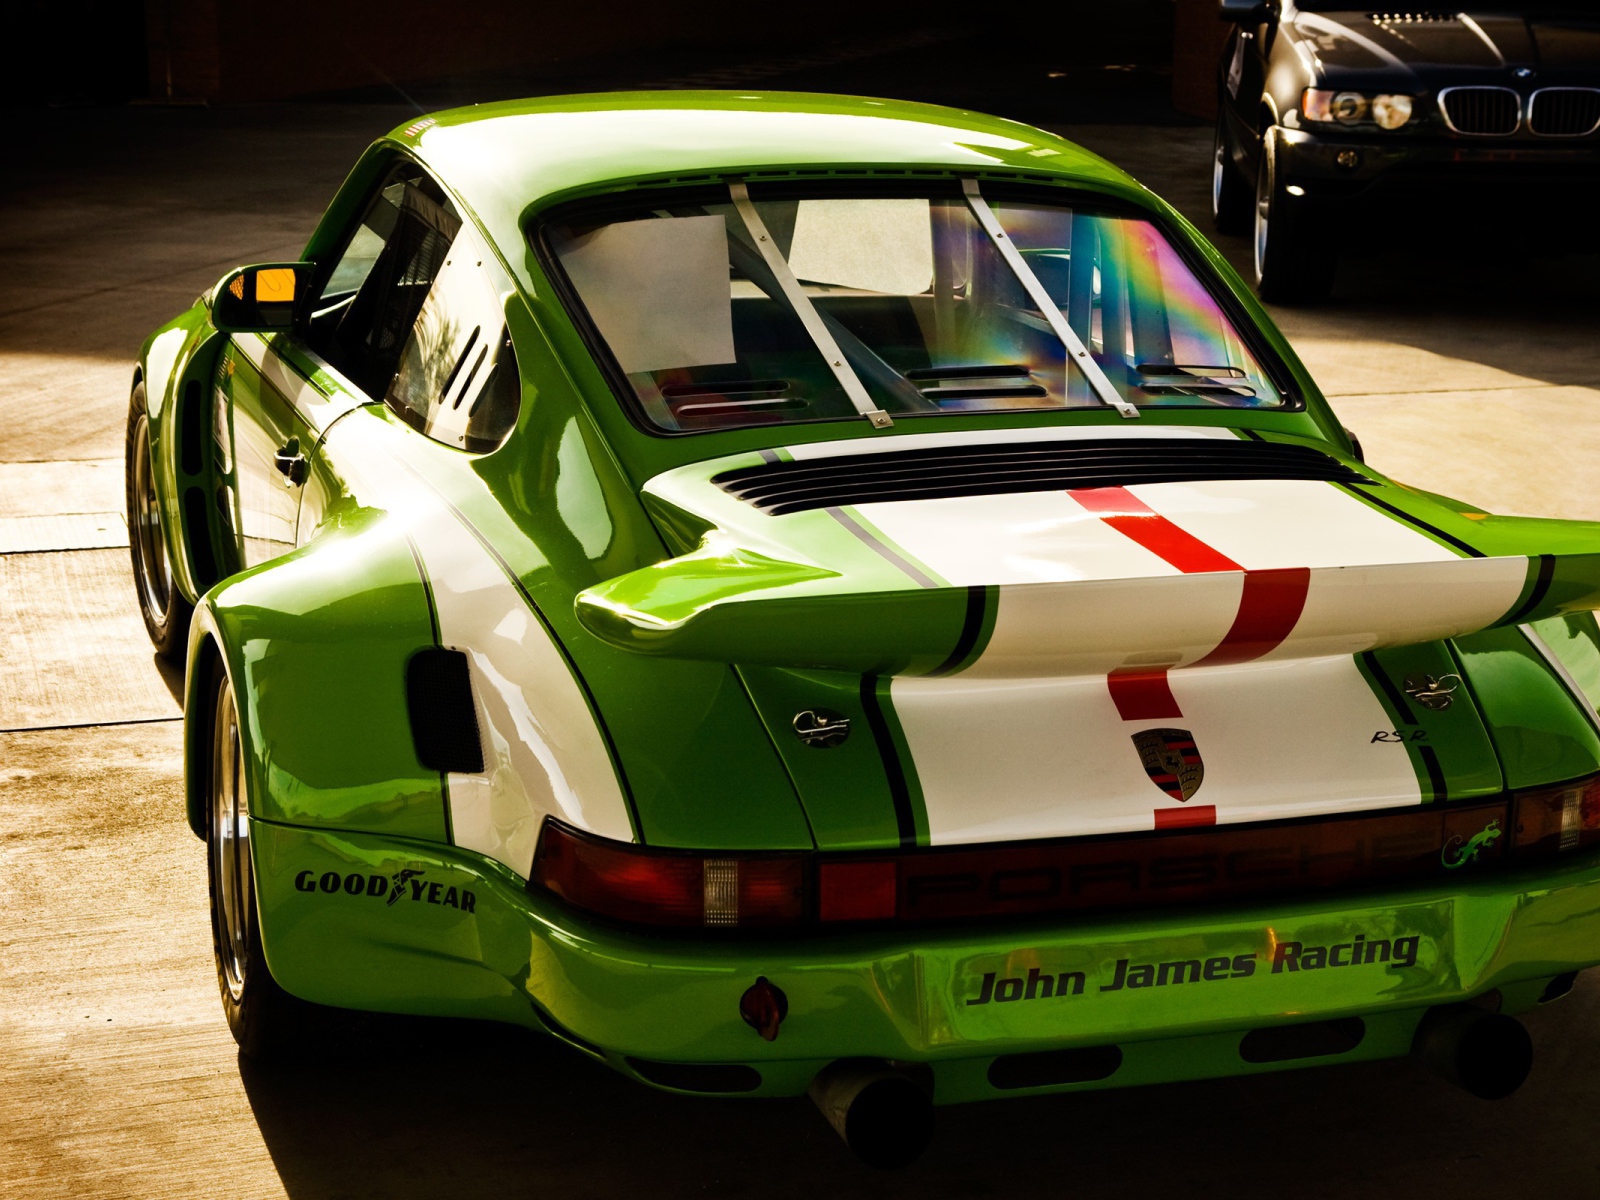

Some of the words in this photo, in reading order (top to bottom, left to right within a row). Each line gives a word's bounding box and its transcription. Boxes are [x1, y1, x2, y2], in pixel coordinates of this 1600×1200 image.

[906, 832, 1427, 907] PORSCHE
[966, 967, 1086, 1006] John
[1100, 959, 1258, 992] James
[1270, 932, 1420, 974] Racing
